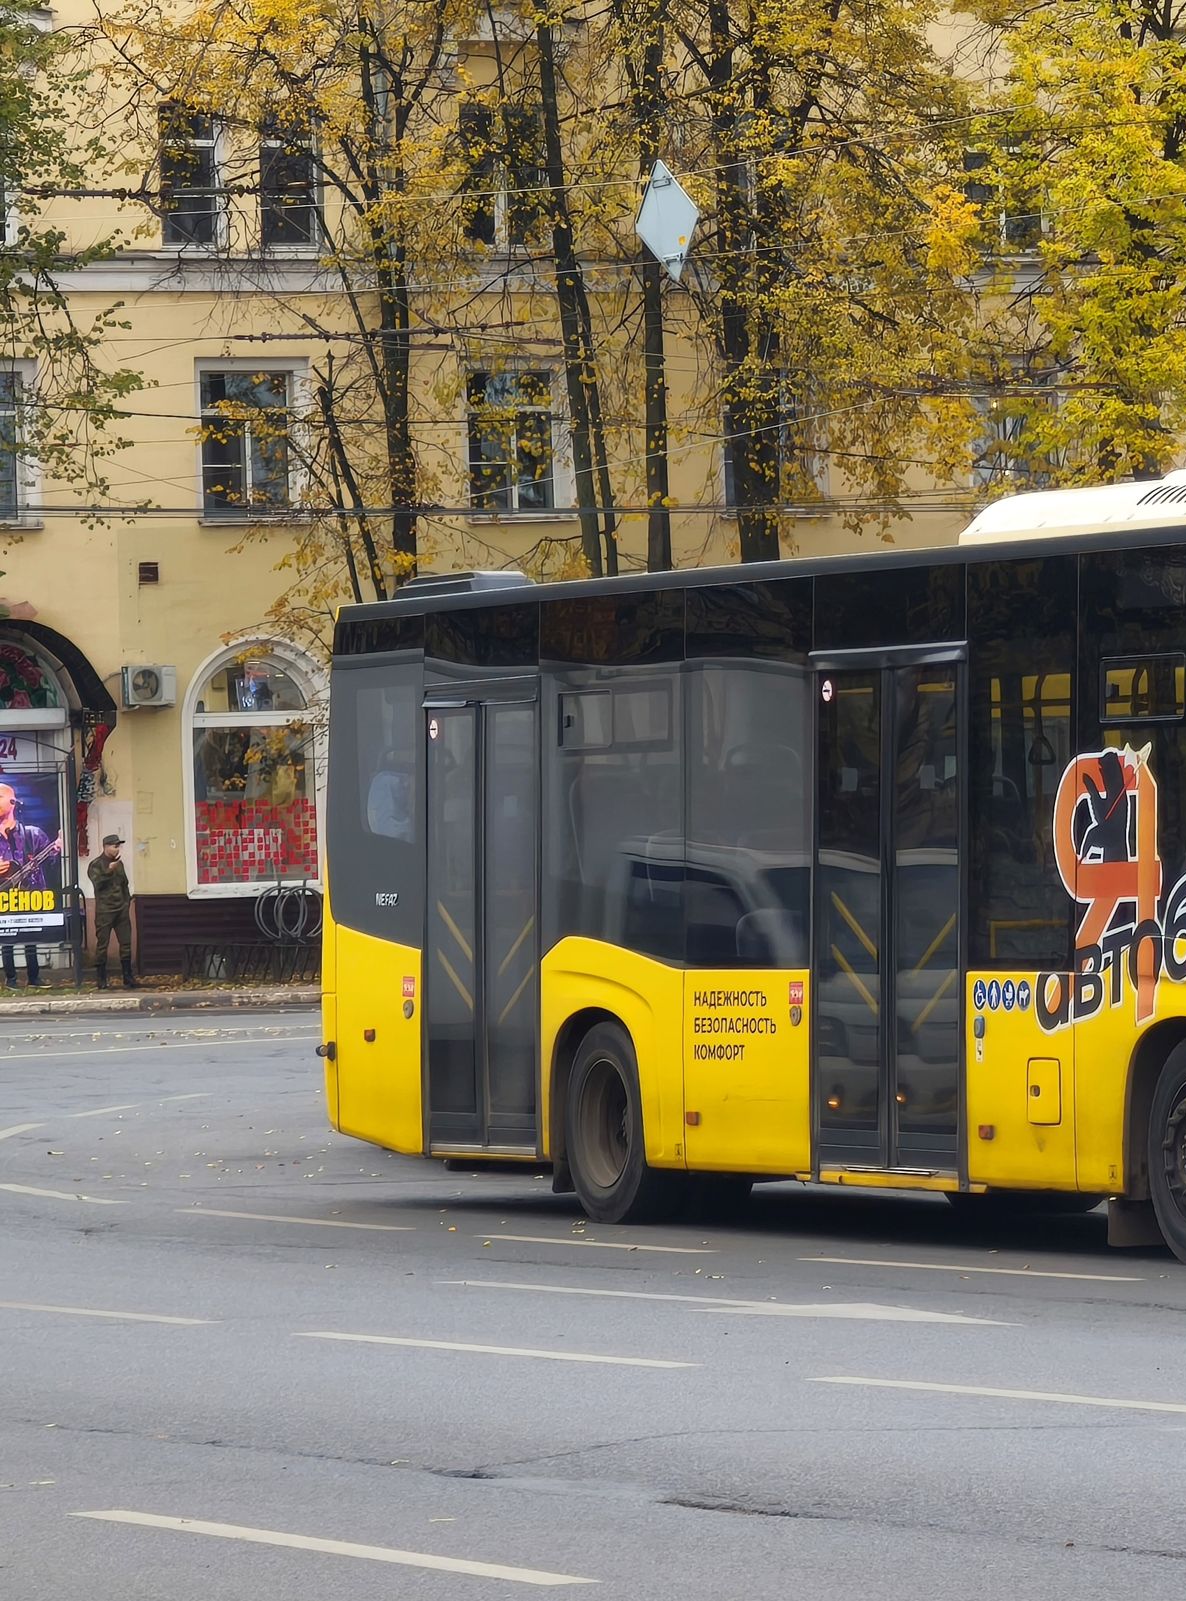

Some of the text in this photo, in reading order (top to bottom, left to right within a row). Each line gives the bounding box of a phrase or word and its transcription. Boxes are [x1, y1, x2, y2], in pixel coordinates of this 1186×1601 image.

[375, 892, 399, 907] NEFAZ
[693, 990, 767, 1010] НАДЕЖНОСТЬ
[693, 1016, 777, 1034] БЕЗОПАСНОСТЬ
[693, 1043, 745, 1061] КОМФОРТ
